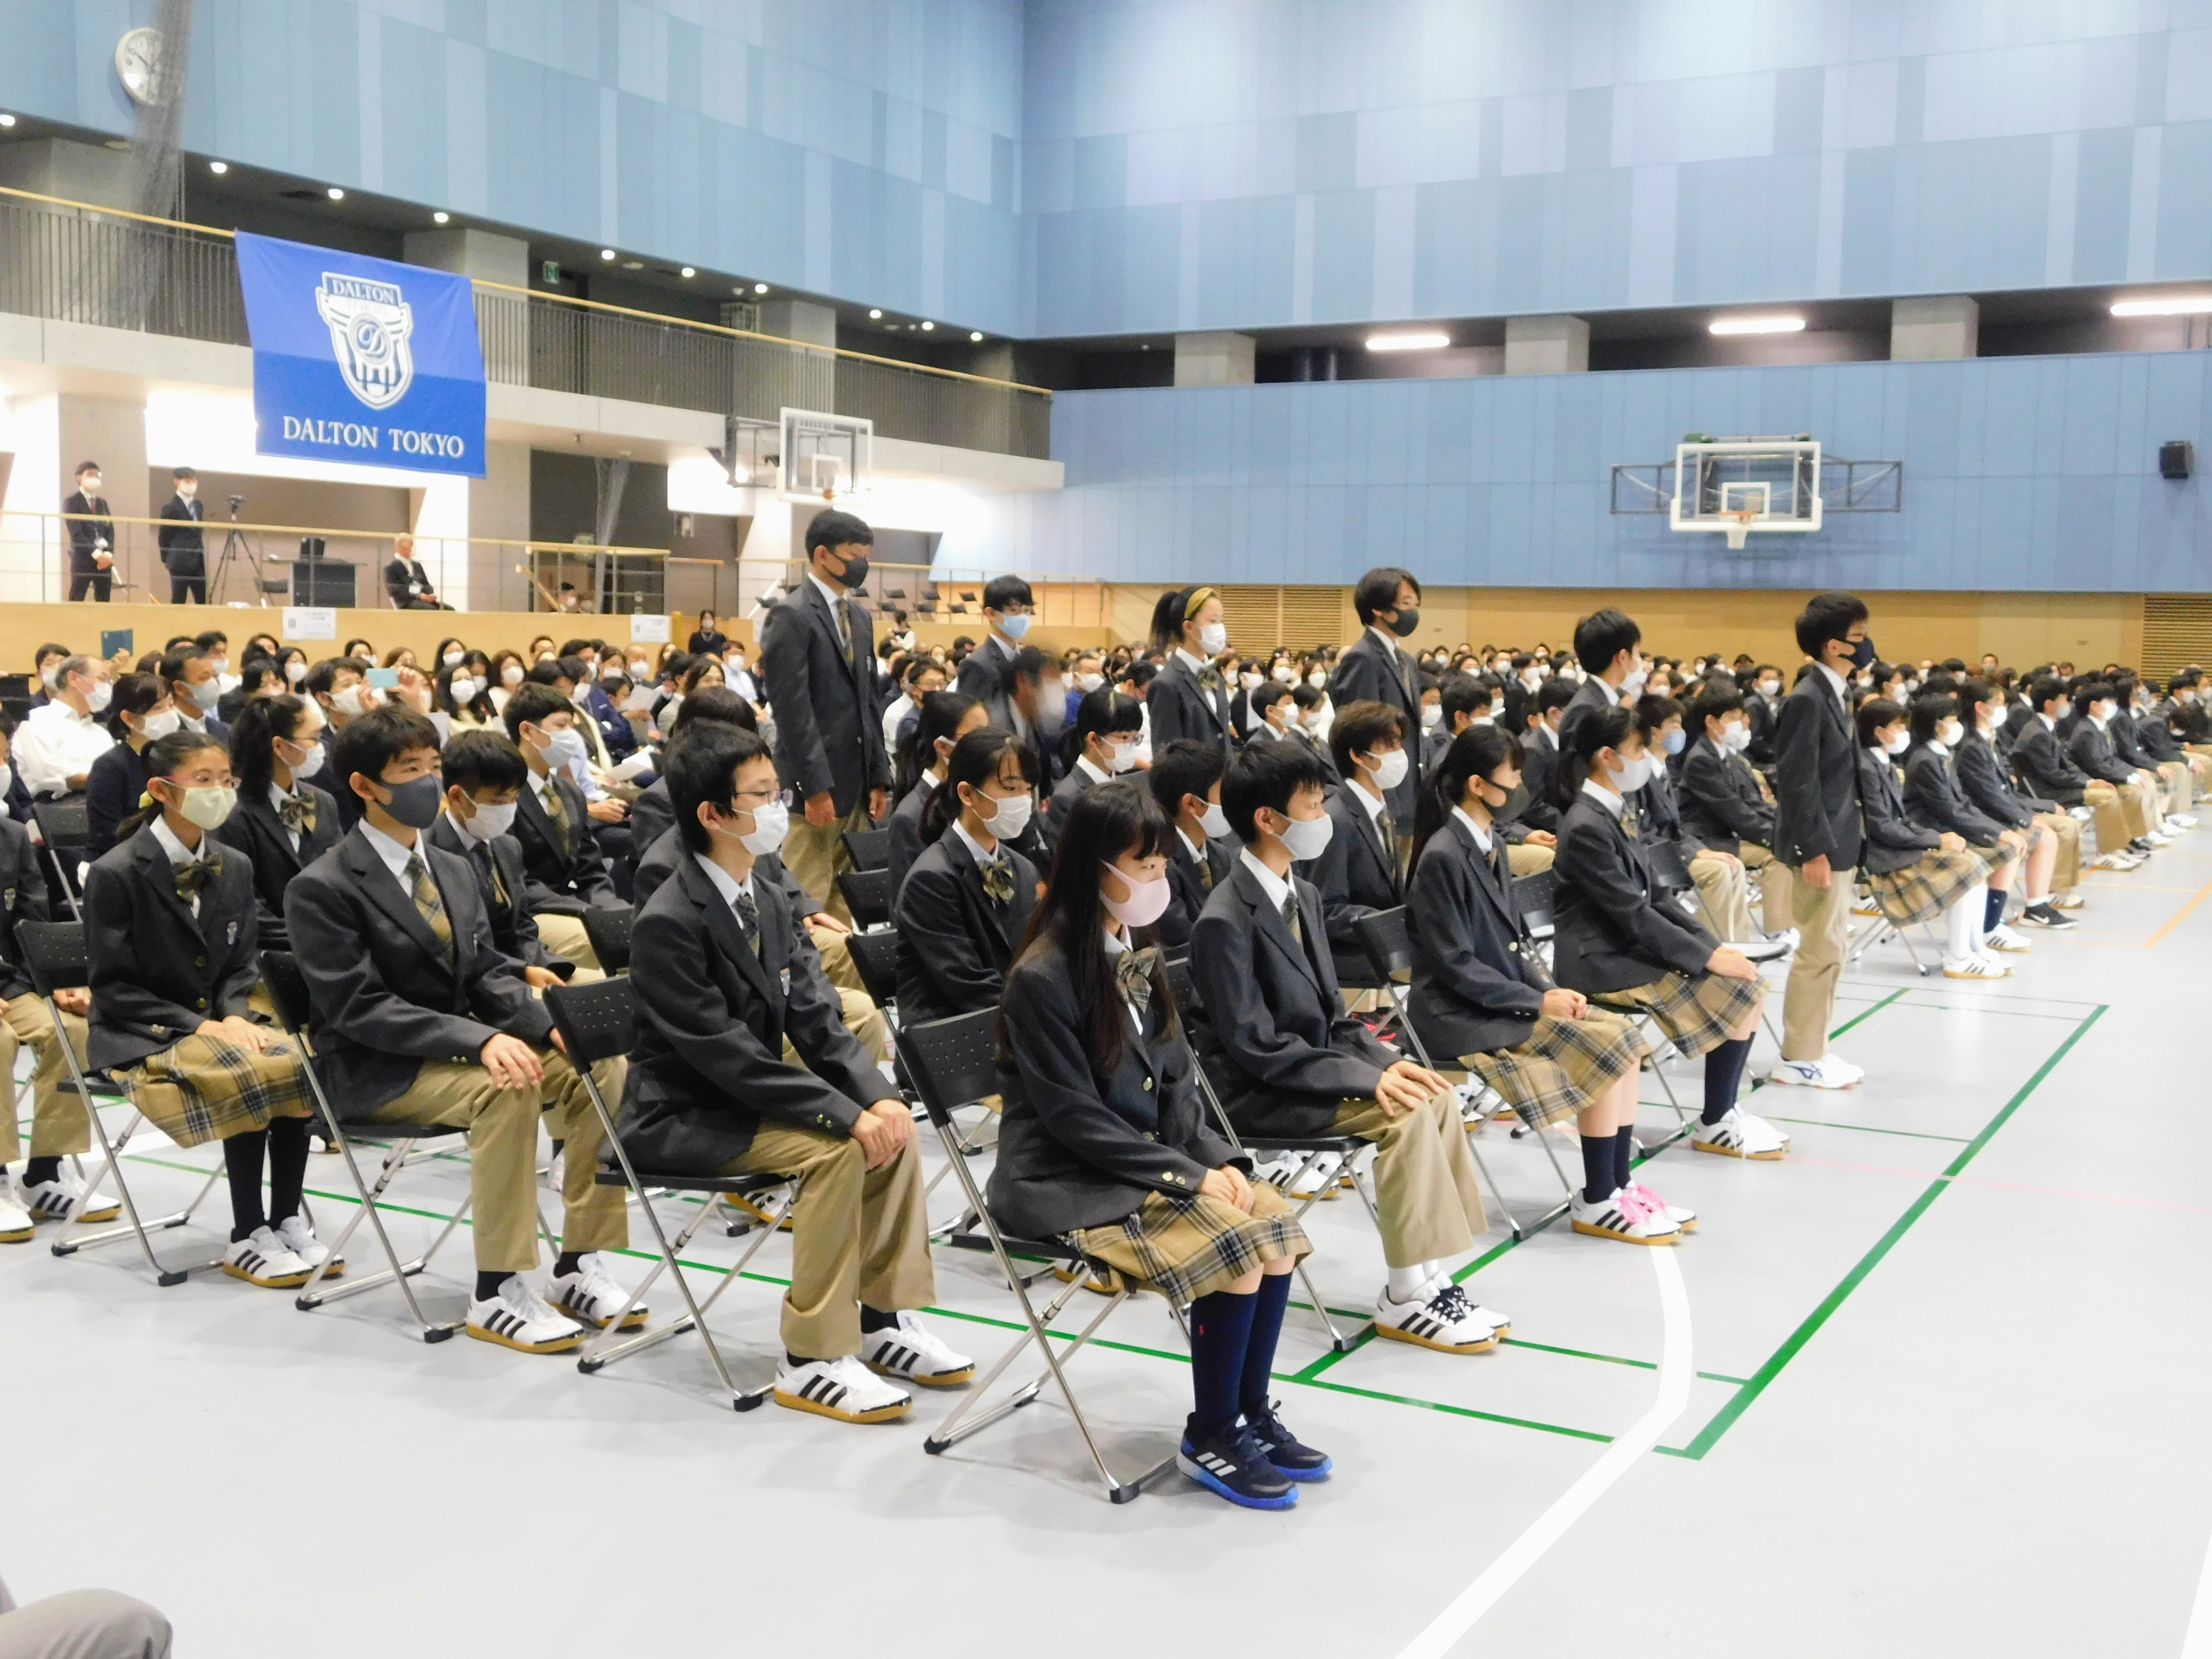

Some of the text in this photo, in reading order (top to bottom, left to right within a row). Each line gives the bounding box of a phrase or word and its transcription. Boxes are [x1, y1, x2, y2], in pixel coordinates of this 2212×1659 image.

[332, 279, 395, 306] DALTON
[283, 415, 465, 458] DALTON TOKYO
